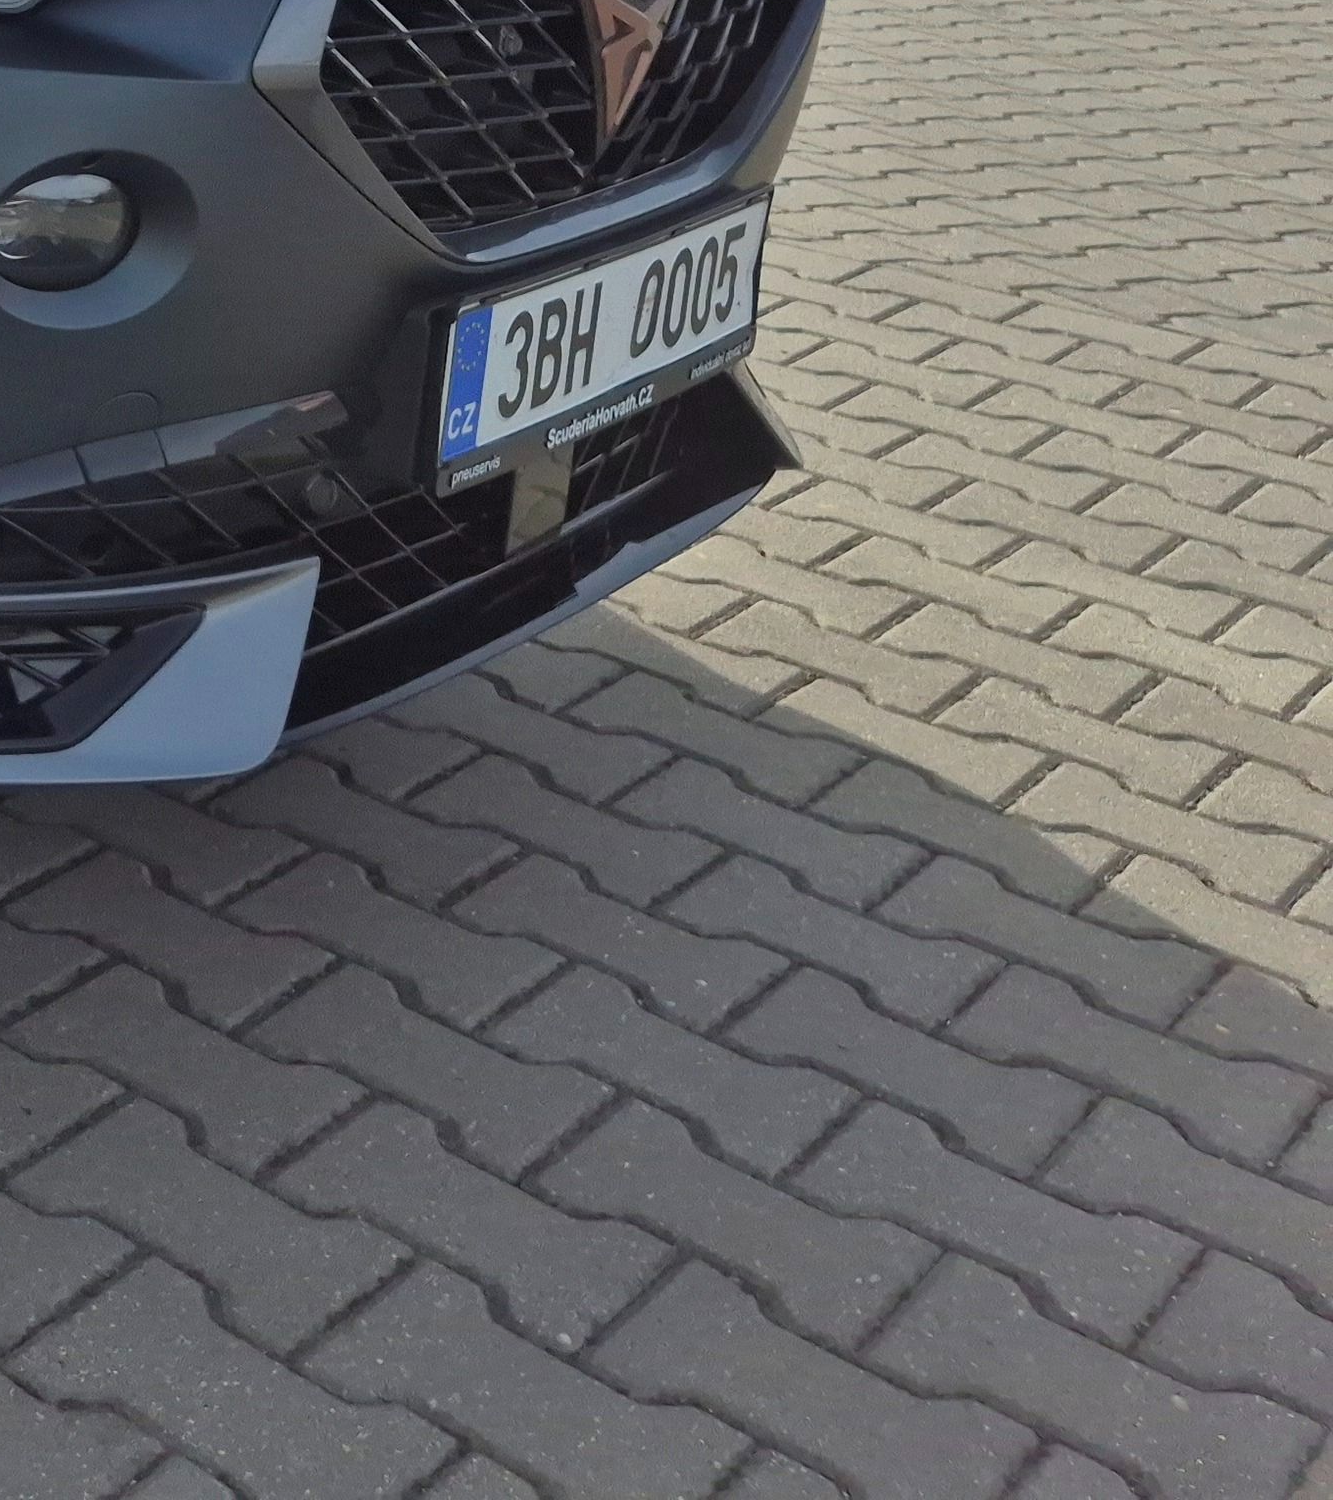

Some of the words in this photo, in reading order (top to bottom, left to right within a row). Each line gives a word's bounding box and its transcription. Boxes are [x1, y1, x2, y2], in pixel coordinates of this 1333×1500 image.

[447, 401, 476, 440] CZ
[498, 281, 603, 419] 3BH
[629, 221, 747, 359] 0005
[451, 454, 501, 489] pneuservis
[546, 383, 655, 450] ScuderiaHorvath.CZ
